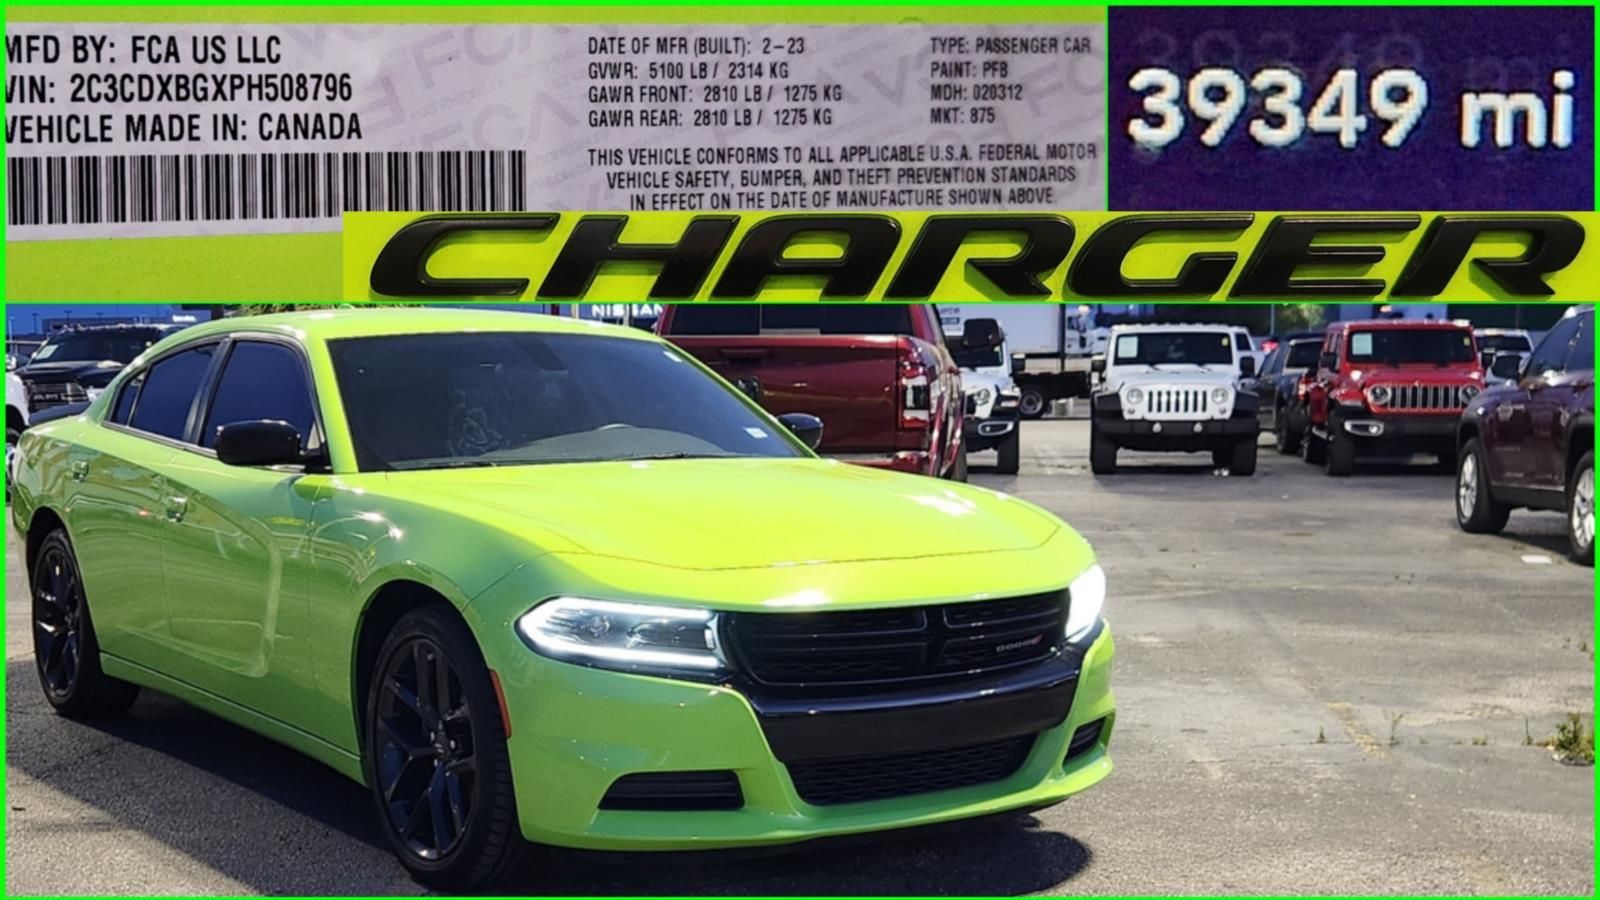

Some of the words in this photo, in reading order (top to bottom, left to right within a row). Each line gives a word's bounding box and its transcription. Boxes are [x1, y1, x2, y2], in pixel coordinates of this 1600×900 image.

[5, 35, 60, 63] MFD
[73, 35, 115, 63] BY:
[132, 35, 180, 64] FCA
[192, 35, 226, 64] US
[237, 35, 281, 64] LLC
[588, 37, 625, 54] DATE
[631, 37, 650, 54] OF
[656, 37, 688, 54] MFR
[693, 37, 751, 58] (BUILT):
[930, 37, 969, 54] TYPE:
[976, 37, 1058, 54] PASSENGER
[1063, 37, 1091, 53] CAR
[588, 62, 638, 79] GVWR:
[649, 62, 683, 79] 5100
[690, 62, 707, 79] LB
[728, 62, 763, 79] 2314
[769, 62, 788, 79] KG
[930, 61, 977, 78] PAINT:
[982, 61, 1009, 78] PFB
[5, 75, 54, 103] VIN:
[70, 73, 352, 102] 2C3CDXBGXPH508796
[588, 85, 634, 103] GAWR
[639, 85, 693, 102] FRONT:
[703, 85, 738, 102] 2810
[744, 85, 762, 102] LB
[784, 84, 817, 102] 1275
[823, 84, 842, 101] KG
[930, 84, 968, 101] MDH:
[973, 84, 1023, 101] 020312
[588, 110, 634, 127] GAWR
[640, 109, 682, 126] REAR:
[694, 109, 727, 126] 2810
[734, 109, 752, 126] LB
[774, 108, 807, 126] 1275
[813, 108, 832, 125] KG
[930, 107, 965, 124] MKT:
[970, 107, 996, 124] 875
[1127, 68, 1428, 148] 39349
[1460, 70, 1575, 148] mi
[5, 114, 113, 143] VEHICLE
[126, 114, 201, 142] MADE
[213, 113, 246, 141] IN:
[258, 112, 362, 141] CANADA
[588, 148, 623, 166] THIS
[628, 148, 691, 166] VEHICLE
[697, 147, 778, 165] CONFORMS
[784, 146, 801, 163] TO
[808, 146, 834, 163] ALL
[840, 145, 925, 163] APPLICABLE
[930, 144, 973, 162] U.S.A.
[979, 143, 1040, 161] FEDERAL
[1046, 143, 1097, 160] MOTOR
[607, 171, 670, 189] VEHICLE
[675, 170, 735, 189] SAFETY,
[741, 169, 807, 188] BUMPER,
[813, 168, 842, 186] AND
[848, 167, 891, 186] THEFT
[898, 166, 985, 185] PREVENTION
[991, 165, 1077, 183] STANDARDS
[630, 194, 645, 211] IN
[652, 193, 704, 210] EFFECT
[711, 192, 731, 209] ON
[737, 191, 765, 209] THE
[771, 190, 807, 209] DATE
[812, 190, 832, 208] OF
[837, 188, 944, 207] MANUFACTURE
[949, 187, 1001, 206] SHOWN
[1008, 187, 1058, 205] ABOVE.
[369, 212, 1586, 302] CHARGER
